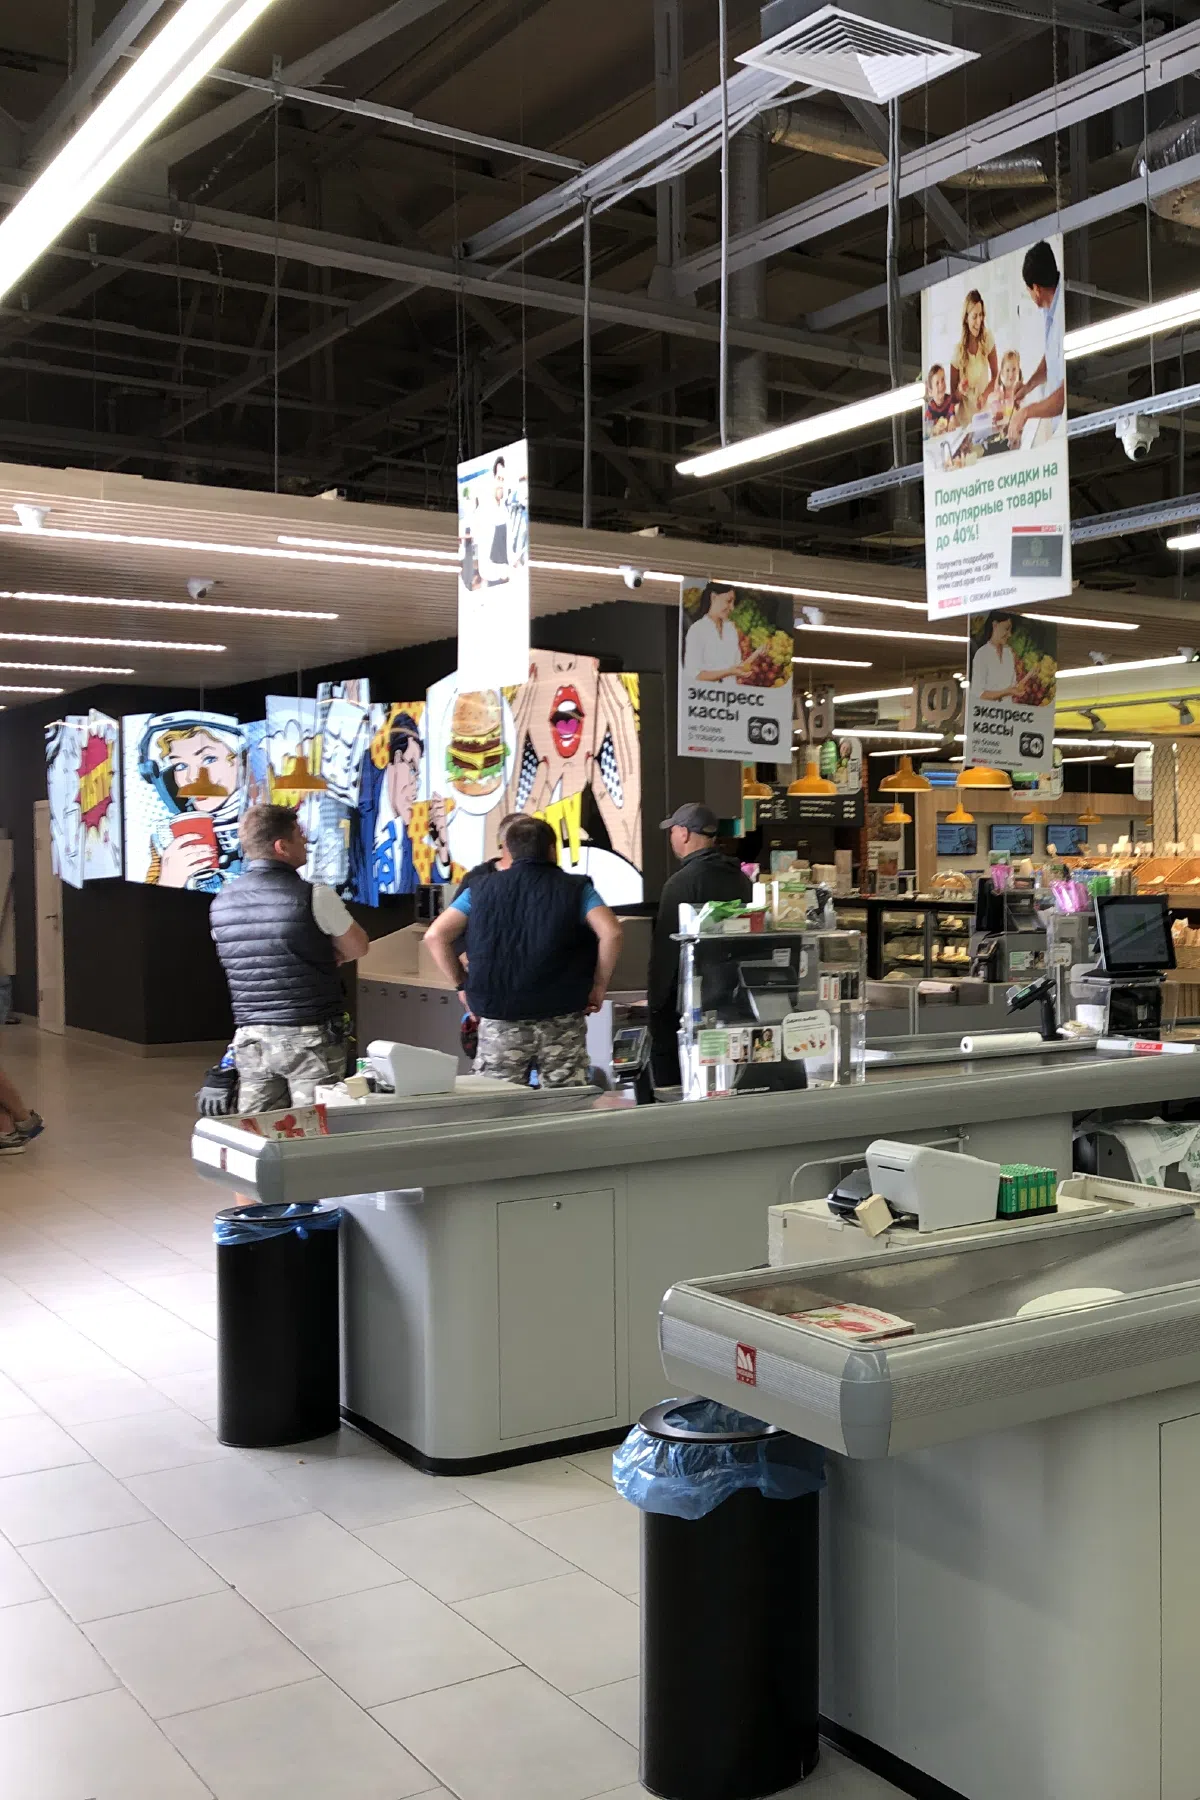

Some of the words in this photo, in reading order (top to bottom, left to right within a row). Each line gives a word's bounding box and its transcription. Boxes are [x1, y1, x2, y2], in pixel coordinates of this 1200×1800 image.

[935, 478, 994, 507] Получайте
[997, 469, 1039, 489] скидки
[1043, 461, 1058, 478] на
[935, 499, 1003, 528] популярные
[1006, 486, 1052, 510] товары
[936, 533, 949, 552] до
[952, 524, 979, 544] 40%!
[687, 687, 764, 707] экспресс
[688, 705, 739, 721] кассы
[973, 705, 1034, 723] экспресс
[973, 721, 1014, 737] кассы
